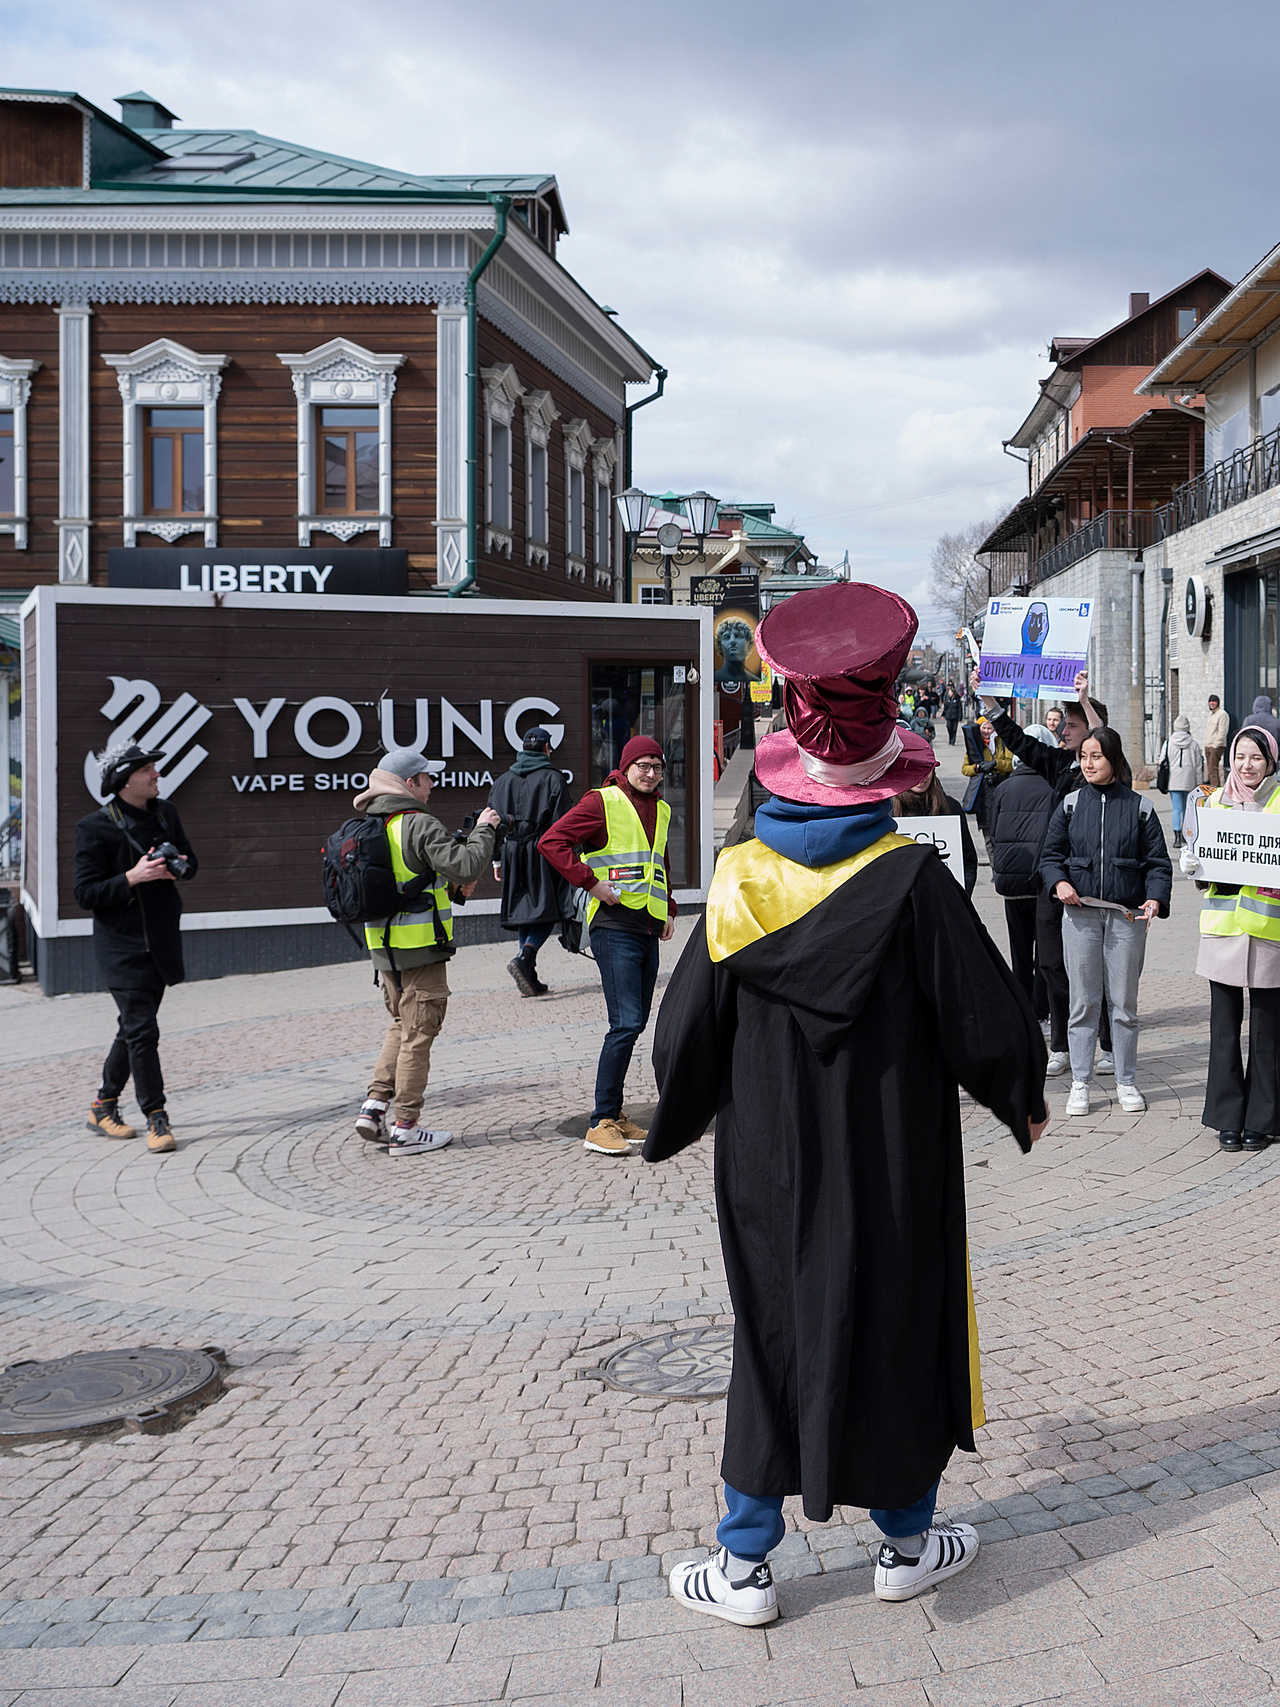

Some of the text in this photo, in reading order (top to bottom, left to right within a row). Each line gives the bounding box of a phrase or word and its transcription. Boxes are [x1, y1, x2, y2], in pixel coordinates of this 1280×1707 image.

[180, 564, 334, 593] LIBERTY
[694, 593, 725, 601] LIBERTY
[984, 661, 1077, 682] ОТПУСТИ ГУСЕЙ!!!
[233, 696, 565, 760] YOUNG
[231, 774, 305, 792] VAPE
[1217, 831, 1254, 846] МЕСТО
[1198, 846, 1237, 861] ВАШЕЙ
